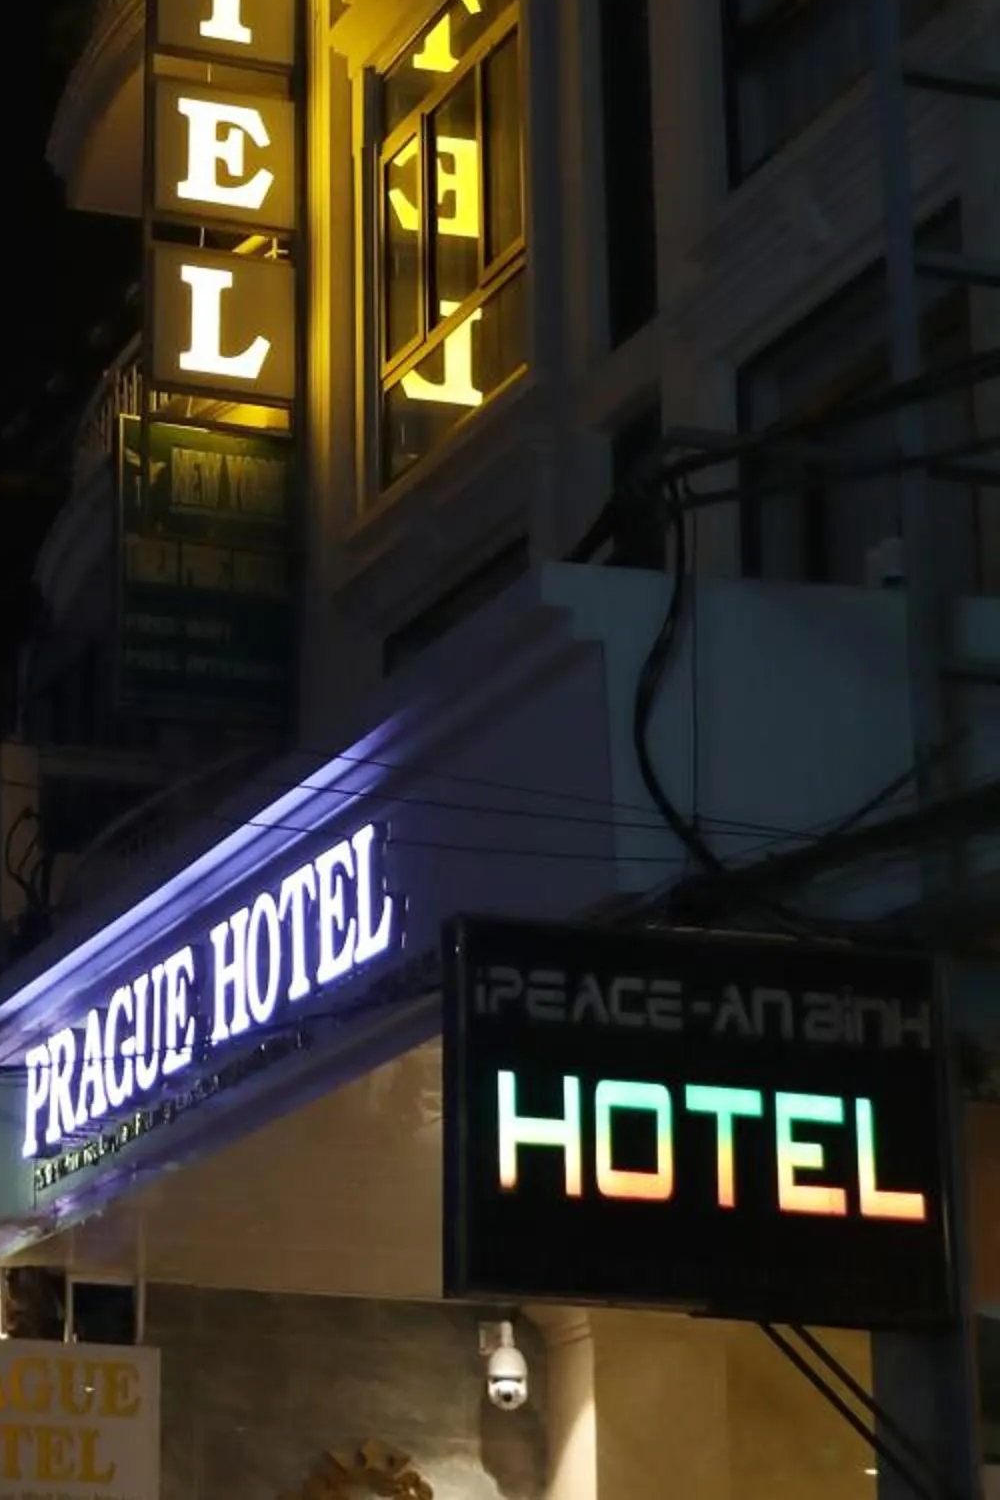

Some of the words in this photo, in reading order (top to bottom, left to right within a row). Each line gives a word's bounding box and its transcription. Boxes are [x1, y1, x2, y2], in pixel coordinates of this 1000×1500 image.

[22, 945, 197, 1159] PRAGUE
[209, 823, 393, 1046] HOTEL
[498, 1070, 925, 1221] HOTEL
